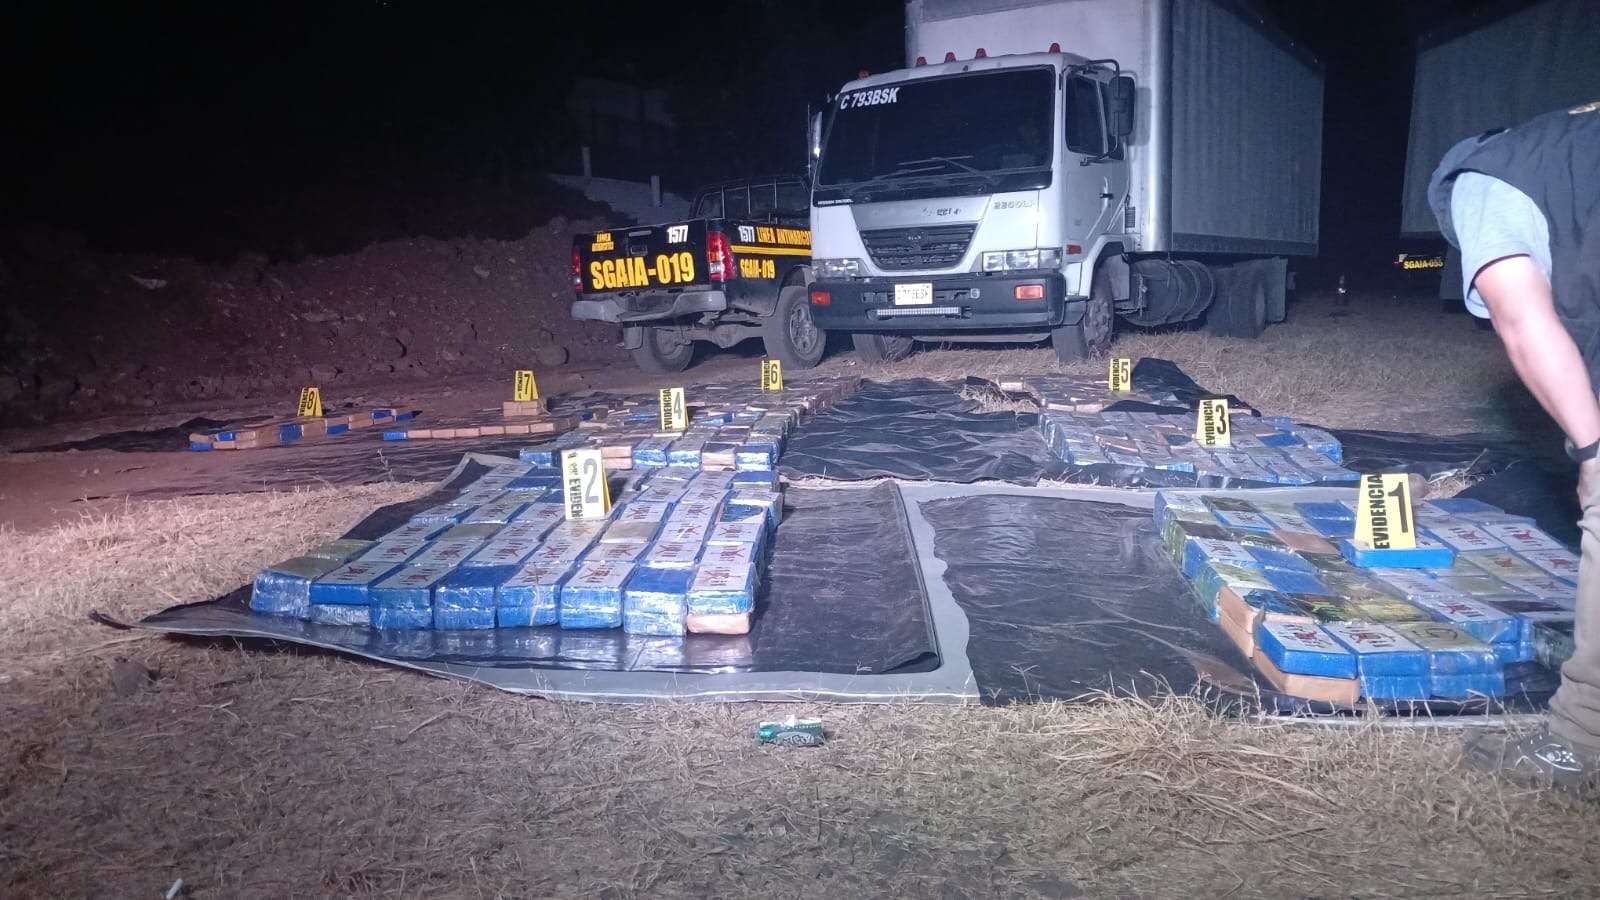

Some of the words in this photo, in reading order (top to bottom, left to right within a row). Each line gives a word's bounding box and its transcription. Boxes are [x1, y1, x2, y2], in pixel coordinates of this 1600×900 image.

[840, 94, 850, 110] C
[851, 87, 900, 108] 793BSK
[666, 225, 689, 243] 1577
[738, 225, 755, 242] 1577
[590, 252, 695, 290] SGAIA-019
[740, 258, 776, 279] SGAIA-019
[524, 373, 530, 395] 7
[771, 363, 778, 384] 6
[1121, 361, 1129, 384] 5
[307, 391, 315, 409] 8
[662, 389, 673, 430] EVIDENCIA
[673, 391, 682, 420] 4
[1202, 400, 1216, 445] EVIDENCIA
[1215, 404, 1227, 435] 3
[583, 457, 599, 504] 2
[1366, 472, 1391, 549] EVIDENCIA
[1387, 481, 1409, 533] 1
